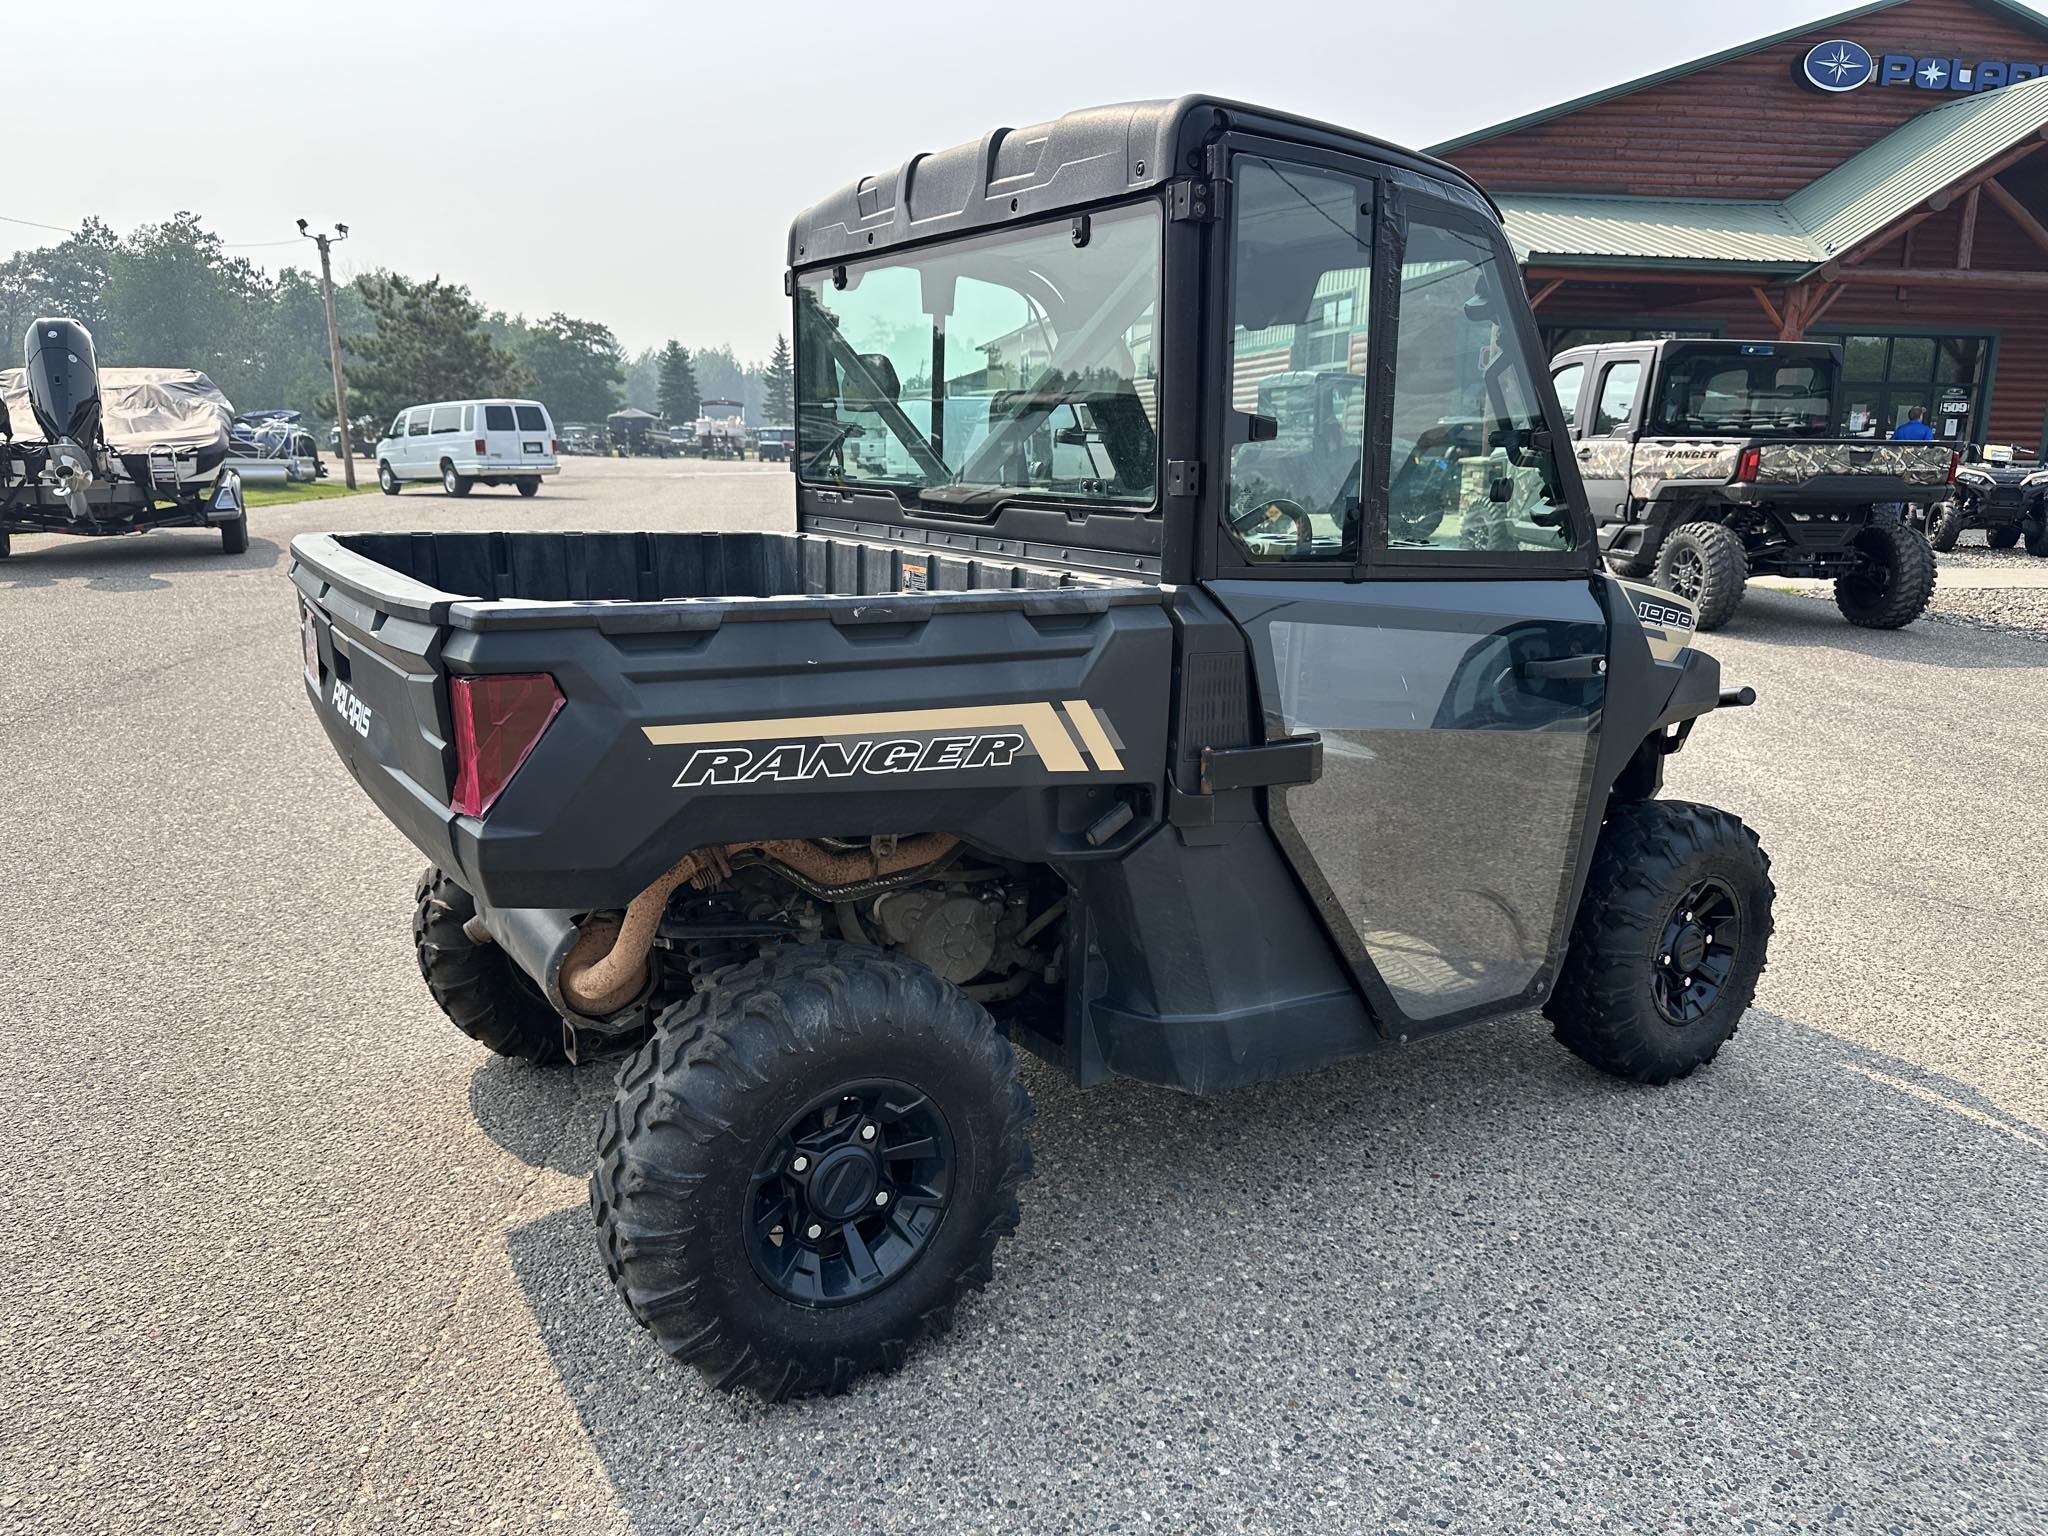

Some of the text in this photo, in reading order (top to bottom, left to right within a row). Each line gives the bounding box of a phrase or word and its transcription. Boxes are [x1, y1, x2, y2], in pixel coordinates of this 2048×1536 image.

[1881, 55, 2048, 92] POLAR
[1942, 402, 1968, 413] 509
[1665, 450, 1719, 459] RANGER
[1638, 601, 1693, 630] 1000
[332, 678, 372, 738] POLARIS
[672, 734, 1024, 787] RANGER
